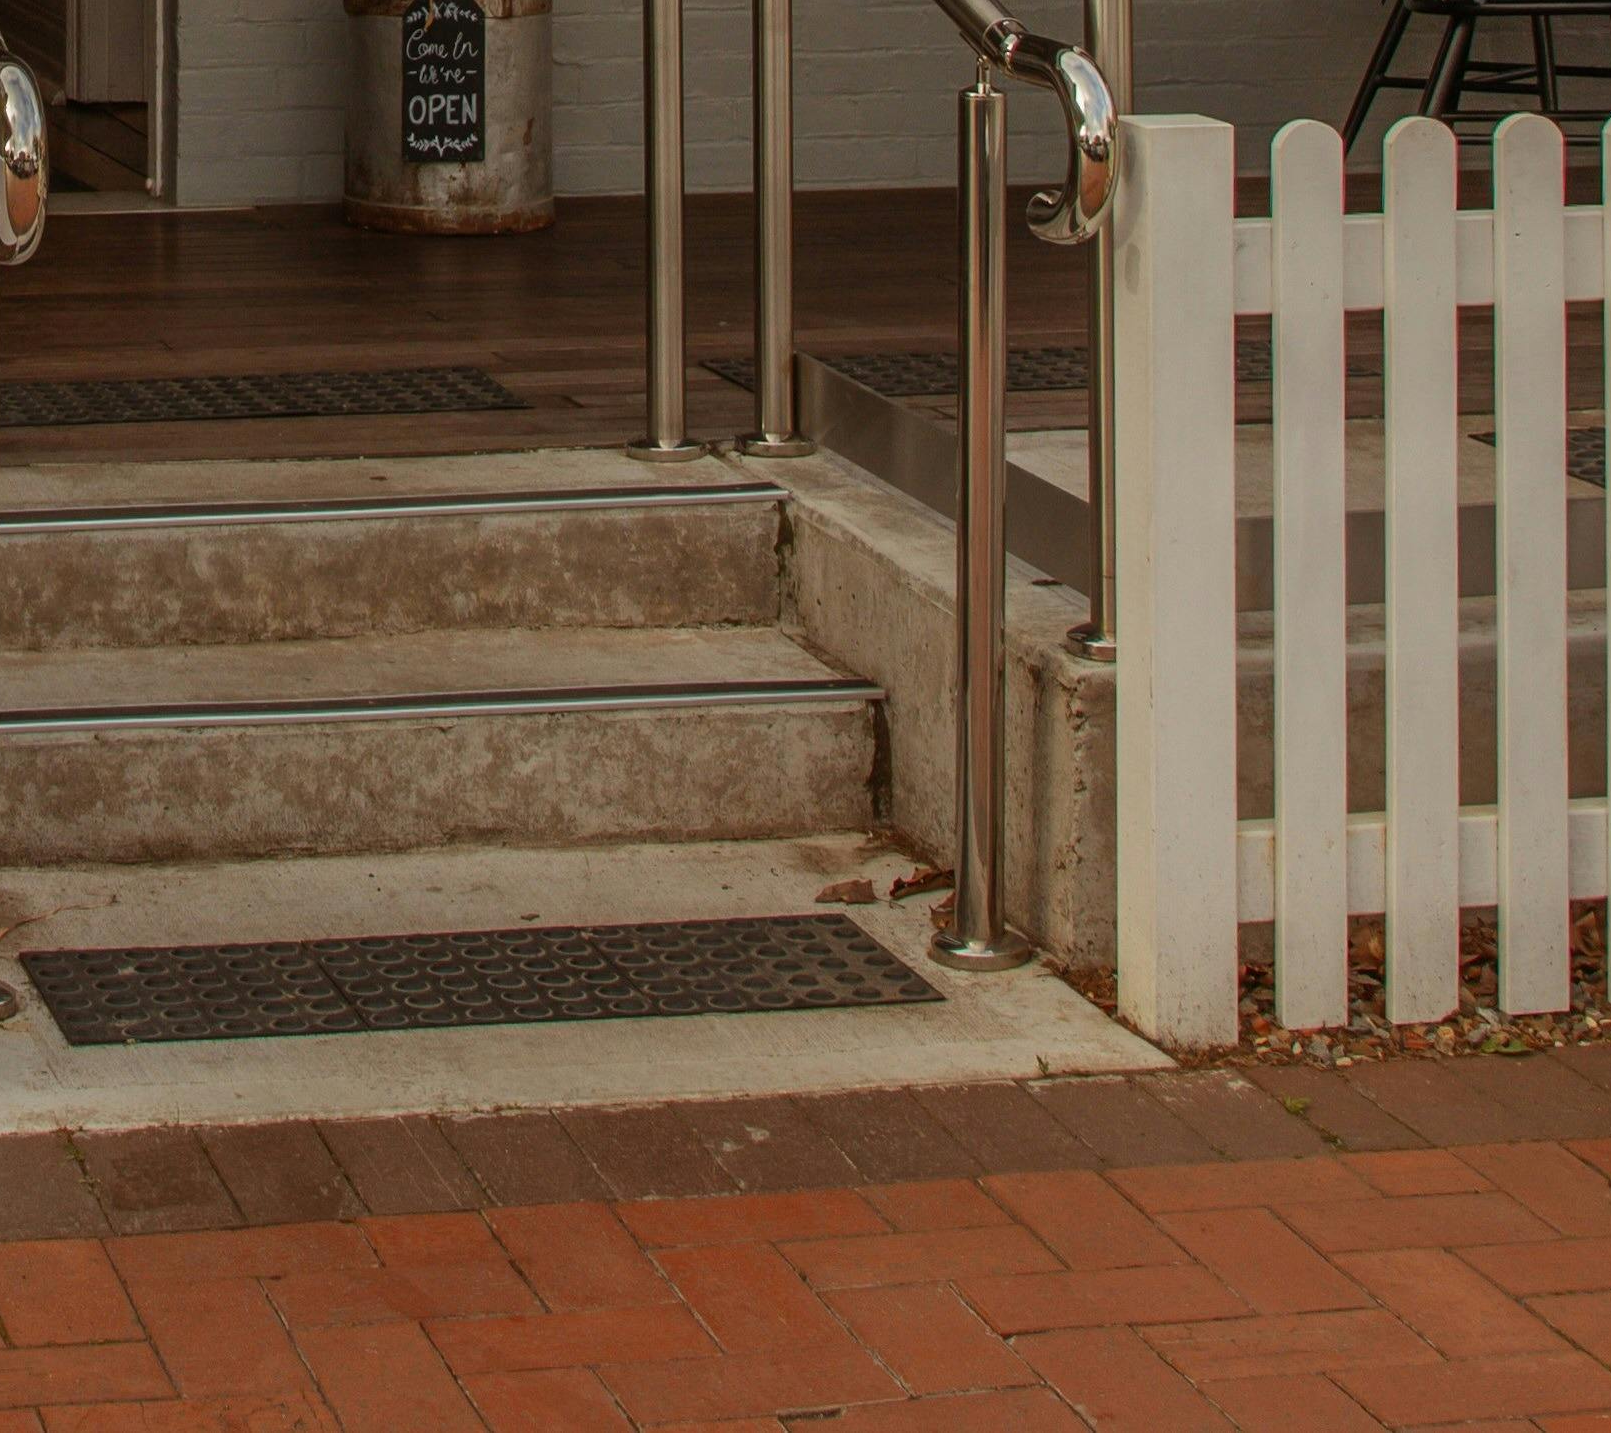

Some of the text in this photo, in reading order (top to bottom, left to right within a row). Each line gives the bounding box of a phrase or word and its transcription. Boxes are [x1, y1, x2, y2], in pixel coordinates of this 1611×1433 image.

[406, 28, 478, 60] Come In
[409, 93, 477, 125] OPEN
